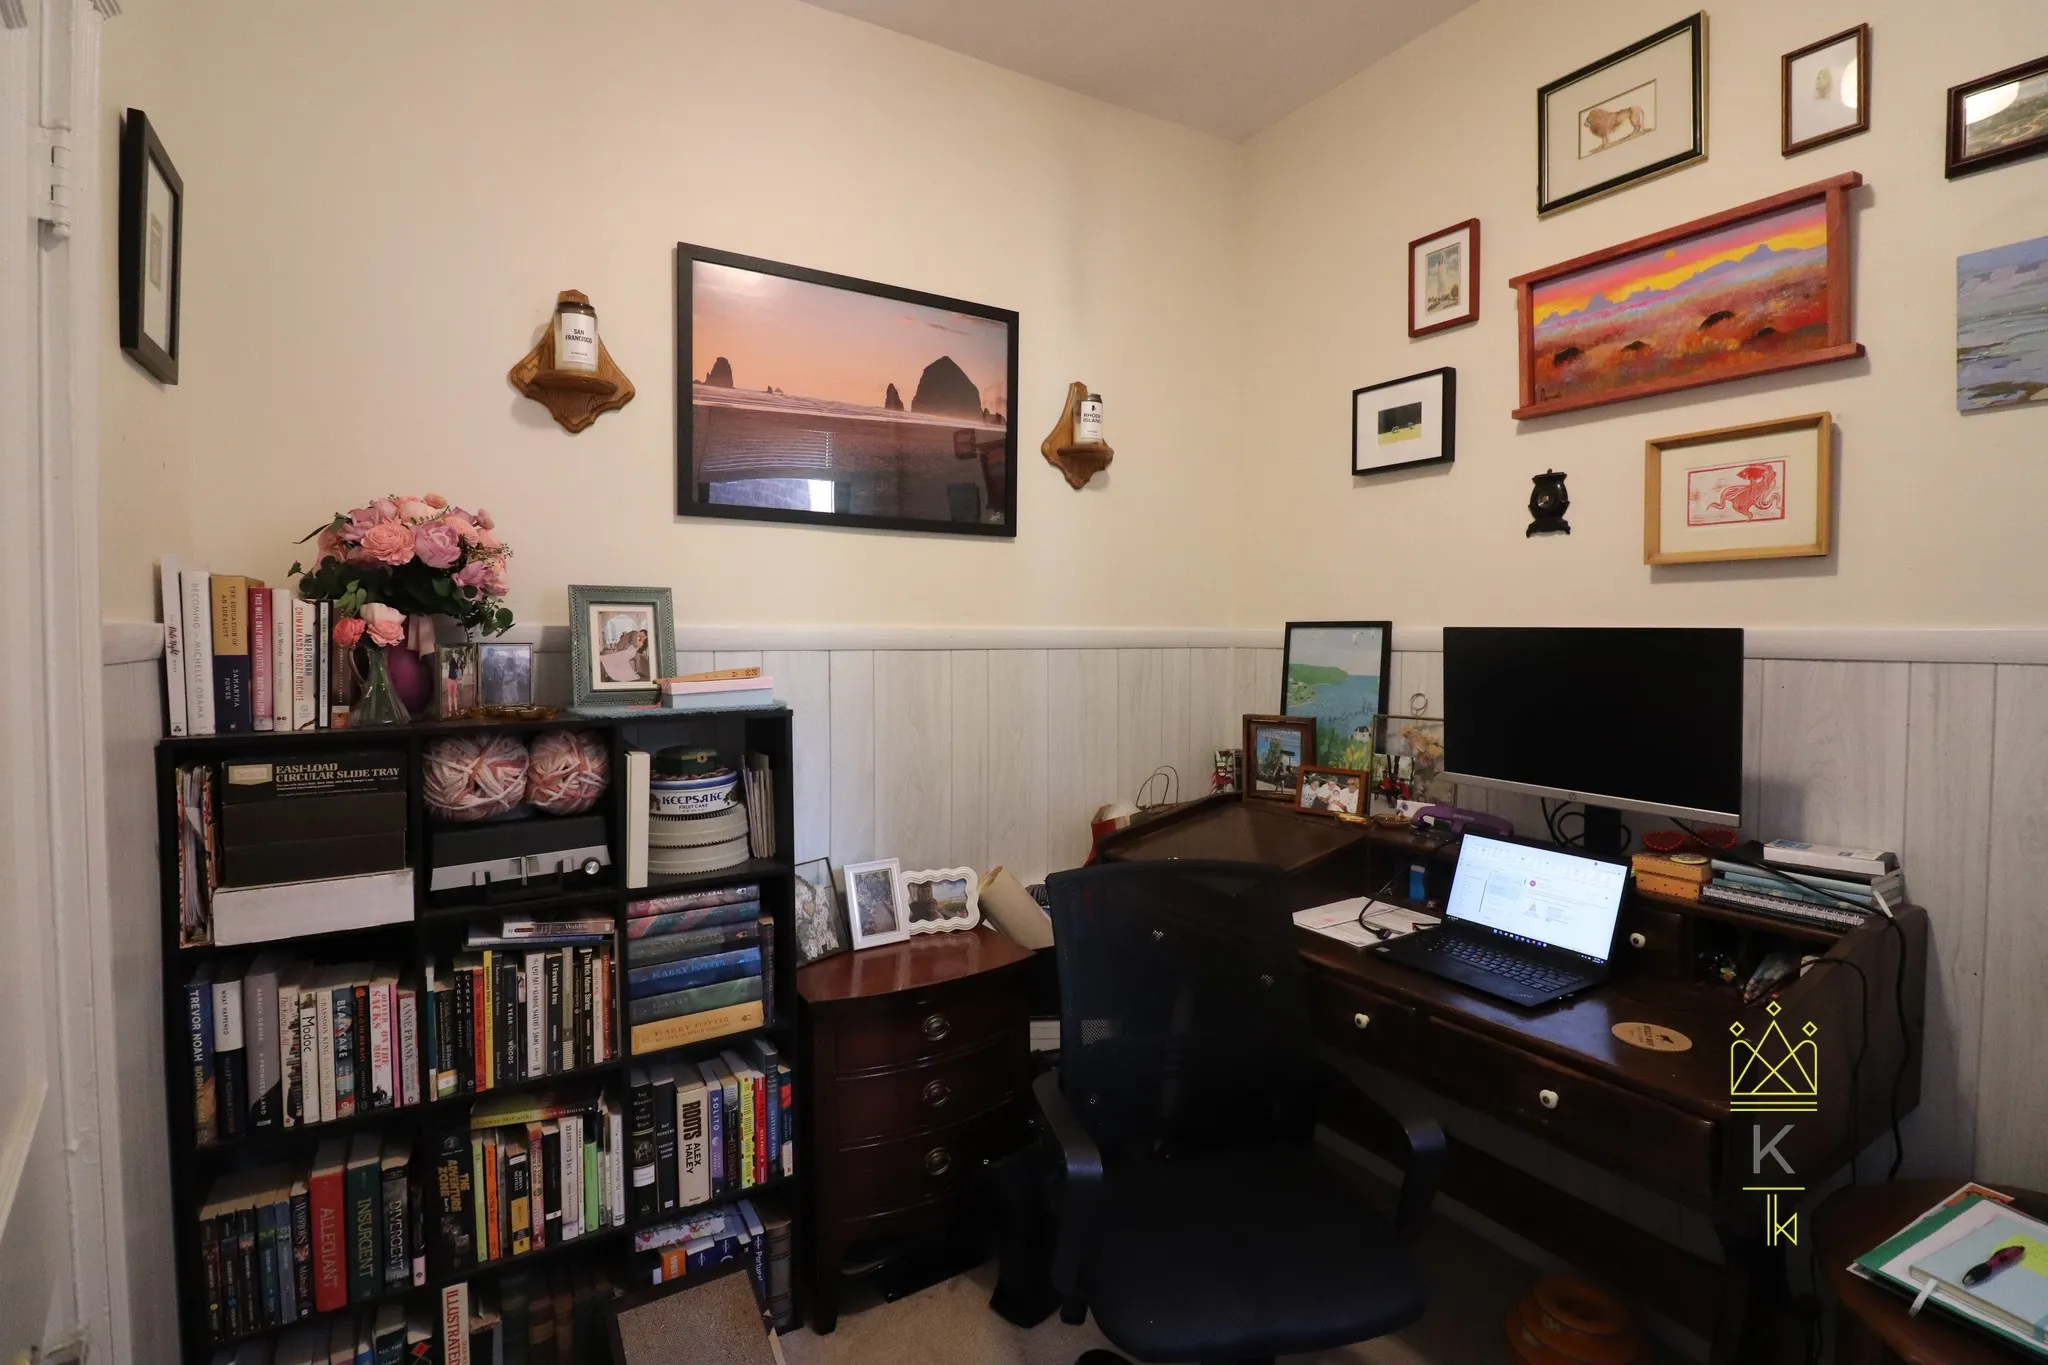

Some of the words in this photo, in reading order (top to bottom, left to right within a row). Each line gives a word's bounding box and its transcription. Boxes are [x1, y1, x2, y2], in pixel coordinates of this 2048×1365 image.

[565, 335, 593, 344] FRANCISCO
[190, 583, 201, 629] BECOMING
[221, 595, 227, 604] AN
[254, 593, 263, 605] THIS
[230, 601, 238, 637] EDUCATION
[254, 606, 263, 619] WILL
[168, 627, 179, 640] Date
[255, 621, 264, 634] ONLY
[295, 607, 304, 651] CHIMAMANDA
[168, 641, 181, 656] Night
[232, 638, 238, 647] OF
[304, 633, 313, 676] AMERICANAH
[193, 642, 204, 683] MICHELLE
[295, 653, 304, 674] NGOZI
[224, 677, 232, 700] POWER
[232, 669, 240, 708] SAMANTHA
[295, 675, 304, 702] ADICHIE
[195, 688, 205, 719] OBAMA
[275, 762, 338, 774] EASI-LOAD
[275, 772, 335, 783] CIRCULAR
[336, 769, 370, 780] SLIDE
[371, 767, 400, 778] TRAY
[662, 792, 723, 805] KEEPSAKE
[565, 922, 588, 930] Walden
[584, 954, 592, 964] The
[584, 964, 592, 976] Nick
[651, 966, 689, 979] HARRY
[691, 959, 727, 972] POTTER
[551, 967, 559, 986] Farewell
[584, 976, 592, 993] Adams
[220, 990, 229, 1005] WHAT
[255, 988, 264, 1015] BARACK
[280, 996, 289, 1008] The
[381, 994, 389, 1024] OLIVER
[551, 993, 559, 1006] Arms
[584, 994, 592, 1011] Stories
[189, 990, 203, 1031] TREVOR
[221, 1007, 230, 1035] HAPPENED
[320, 1002, 330, 1034] BASSOON
[372, 991, 383, 1030] SACKS
[402, 1002, 413, 1028] ANNE
[257, 1018, 265, 1042] OBAMA
[302, 1016, 315, 1053] Modoc
[382, 1031, 390, 1043] ON
[191, 1032, 204, 1062] NOAH
[322, 1037, 331, 1055] KING
[338, 1032, 348, 1058] CAKE
[373, 1045, 383, 1070] MOVE
[382, 1047, 390, 1066] THE
[403, 1029, 414, 1062] FRANK
[507, 1039, 515, 1065] WOODS
[194, 1065, 205, 1089] BORN
[258, 1059, 266, 1093] PROMISED
[259, 1096, 267, 1115] LAND
[712, 1097, 721, 1131] SOLITO
[682, 1100, 702, 1141] ROOTS
[686, 1143, 694, 1174] HALEY
[693, 1142, 702, 1167] ALEX
[437, 1166, 450, 1198] ZONE
[446, 1160, 462, 1213] ADVENTURE
[460, 1172, 471, 1191] THE
[295, 1201, 310, 1246] WARRIORS
[388, 1199, 404, 1270] DIVERGENT
[319, 1207, 338, 1289] ALLEGIANT
[357, 1197, 375, 1278] INSURGENT
[299, 1265, 309, 1299] Midnight
